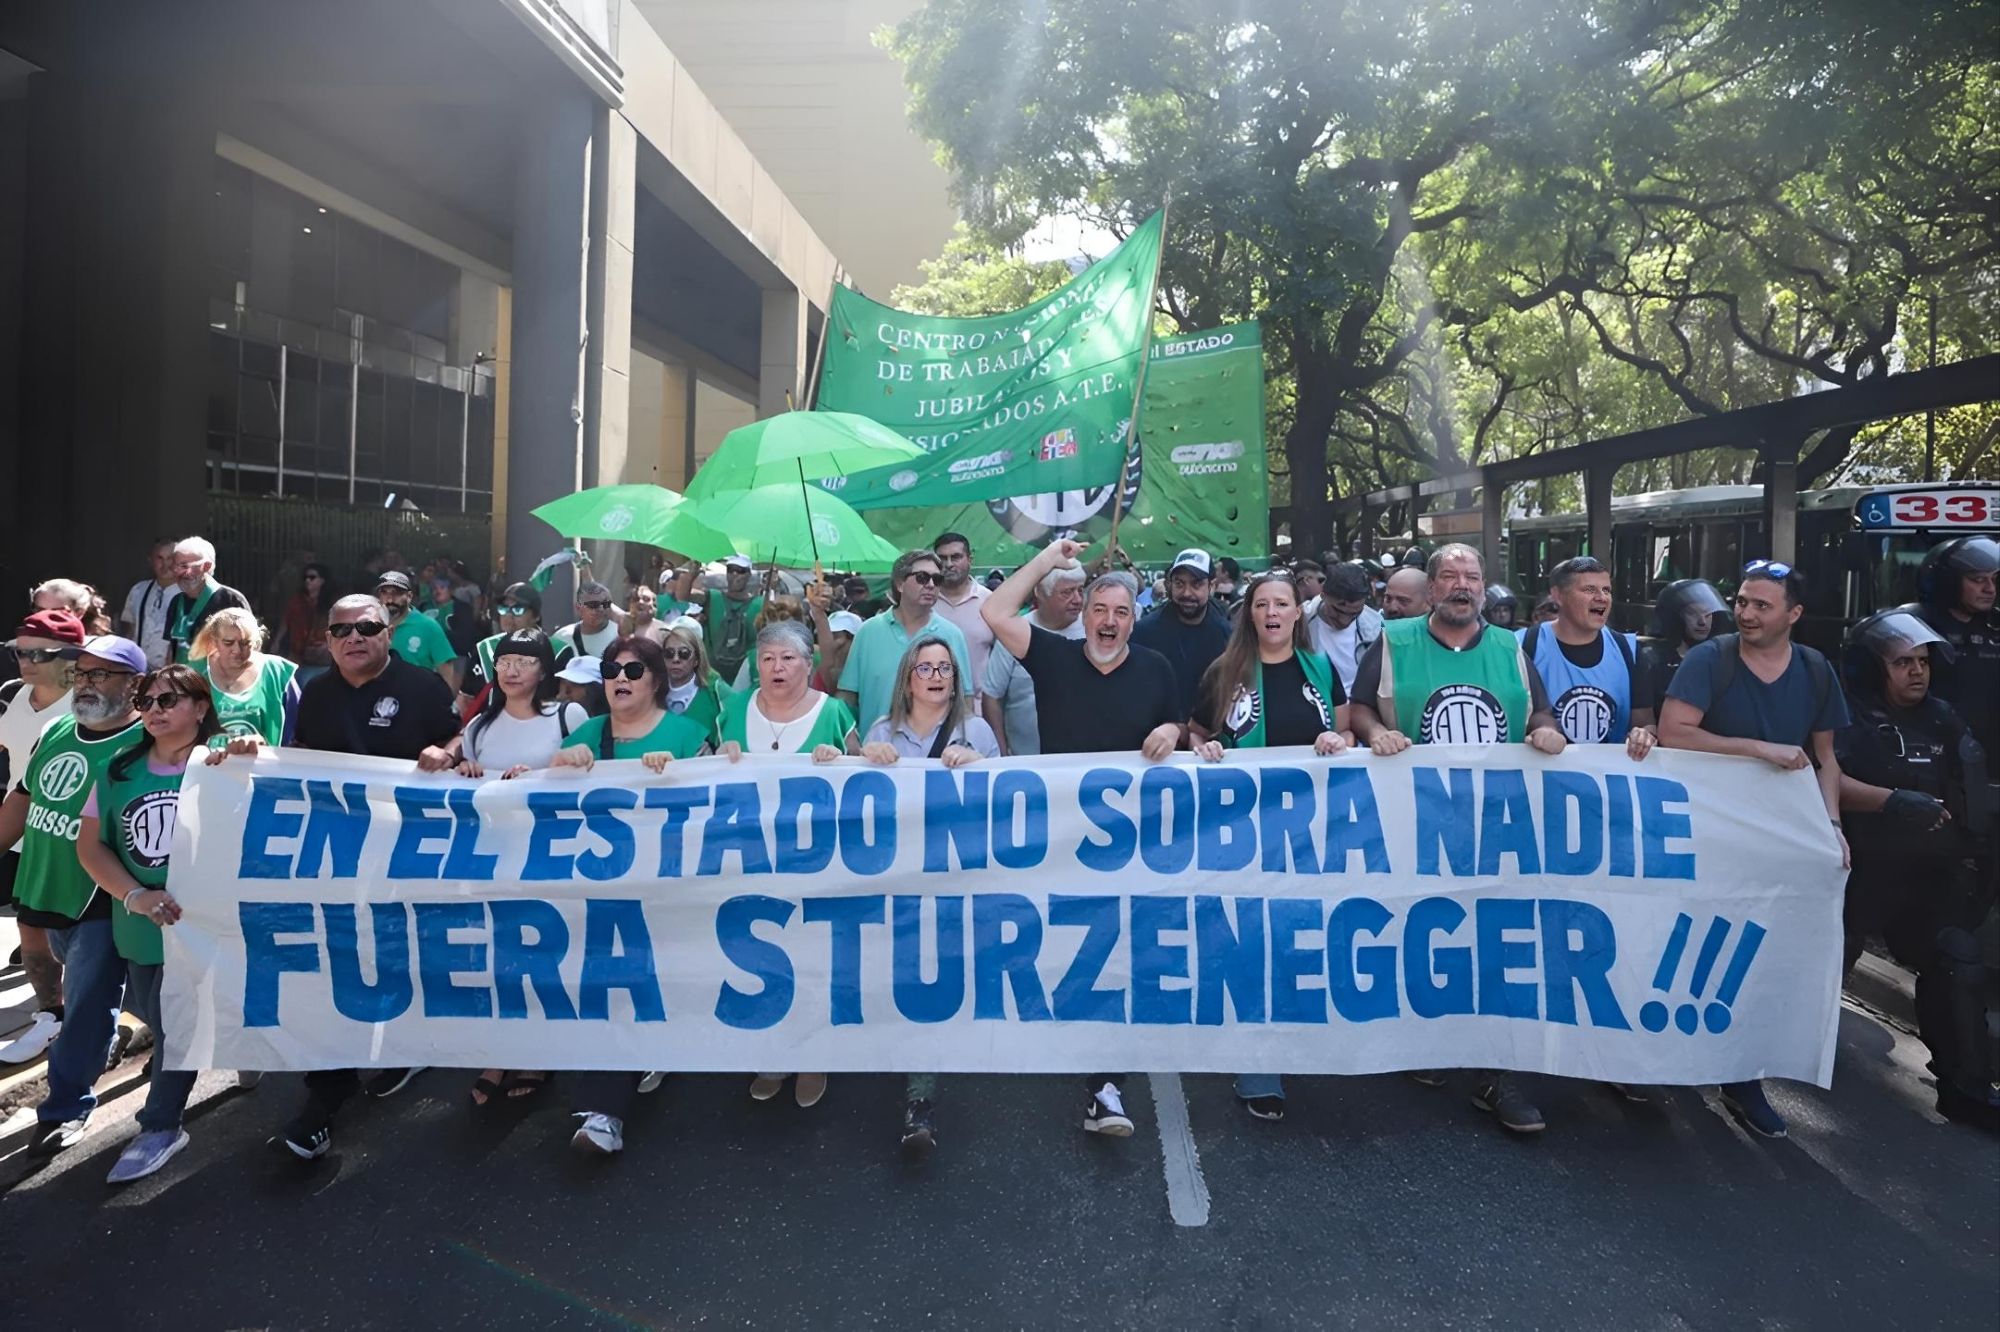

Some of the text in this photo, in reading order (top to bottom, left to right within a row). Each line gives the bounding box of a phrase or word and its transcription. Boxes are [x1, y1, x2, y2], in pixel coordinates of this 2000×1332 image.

[877, 323, 986, 351] CENTRO
[1165, 333, 1234, 357] ESTADO
[878, 361, 913, 381] DE
[1895, 496, 1987, 523] 33
[43, 756, 83, 797] ATE
[239, 764, 1697, 882] EN EL ESTADO NO SOBRA NADIE
[239, 898, 667, 1028] FUERA
